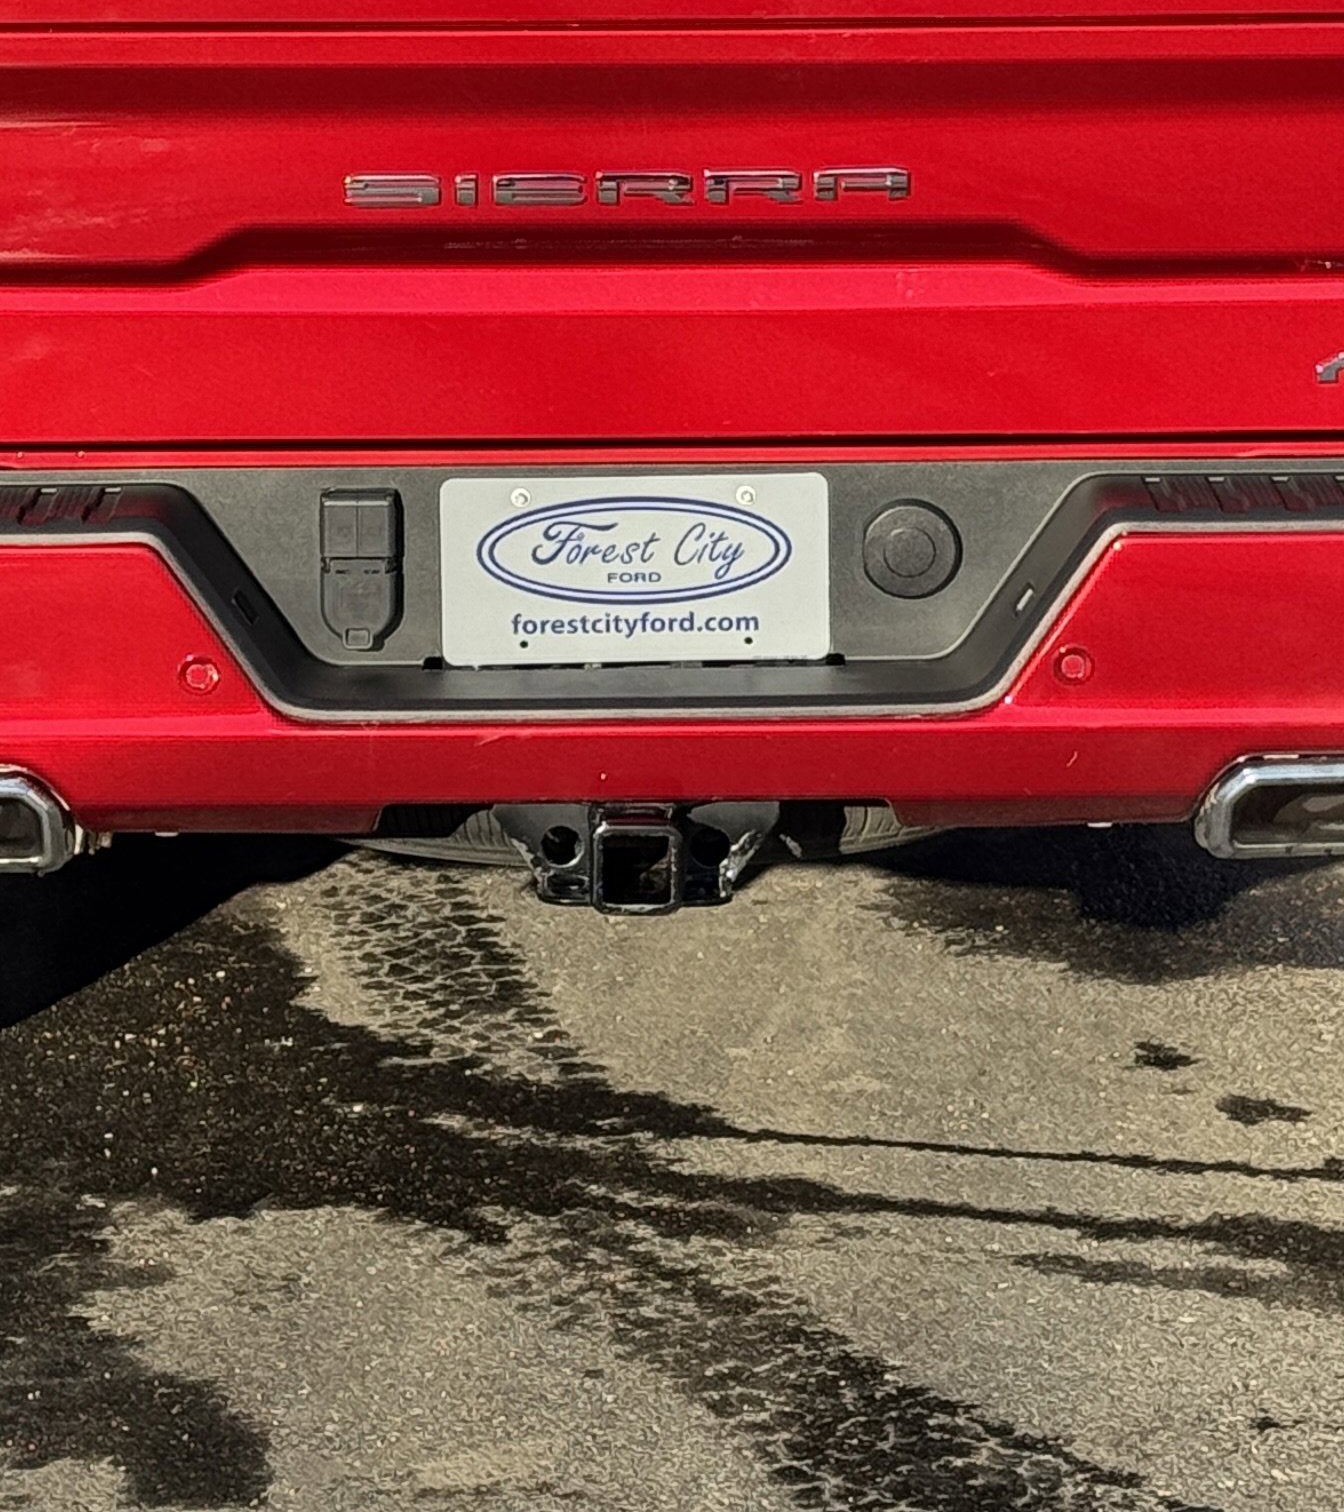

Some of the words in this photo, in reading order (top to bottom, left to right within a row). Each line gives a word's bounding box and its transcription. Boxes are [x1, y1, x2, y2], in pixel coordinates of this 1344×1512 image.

[343, 166, 912, 208] SIERRA
[531, 520, 662, 566] Forest
[673, 521, 746, 580] City
[606, 571, 662, 584] FORD
[511, 611, 760, 639] forestcityford.com
